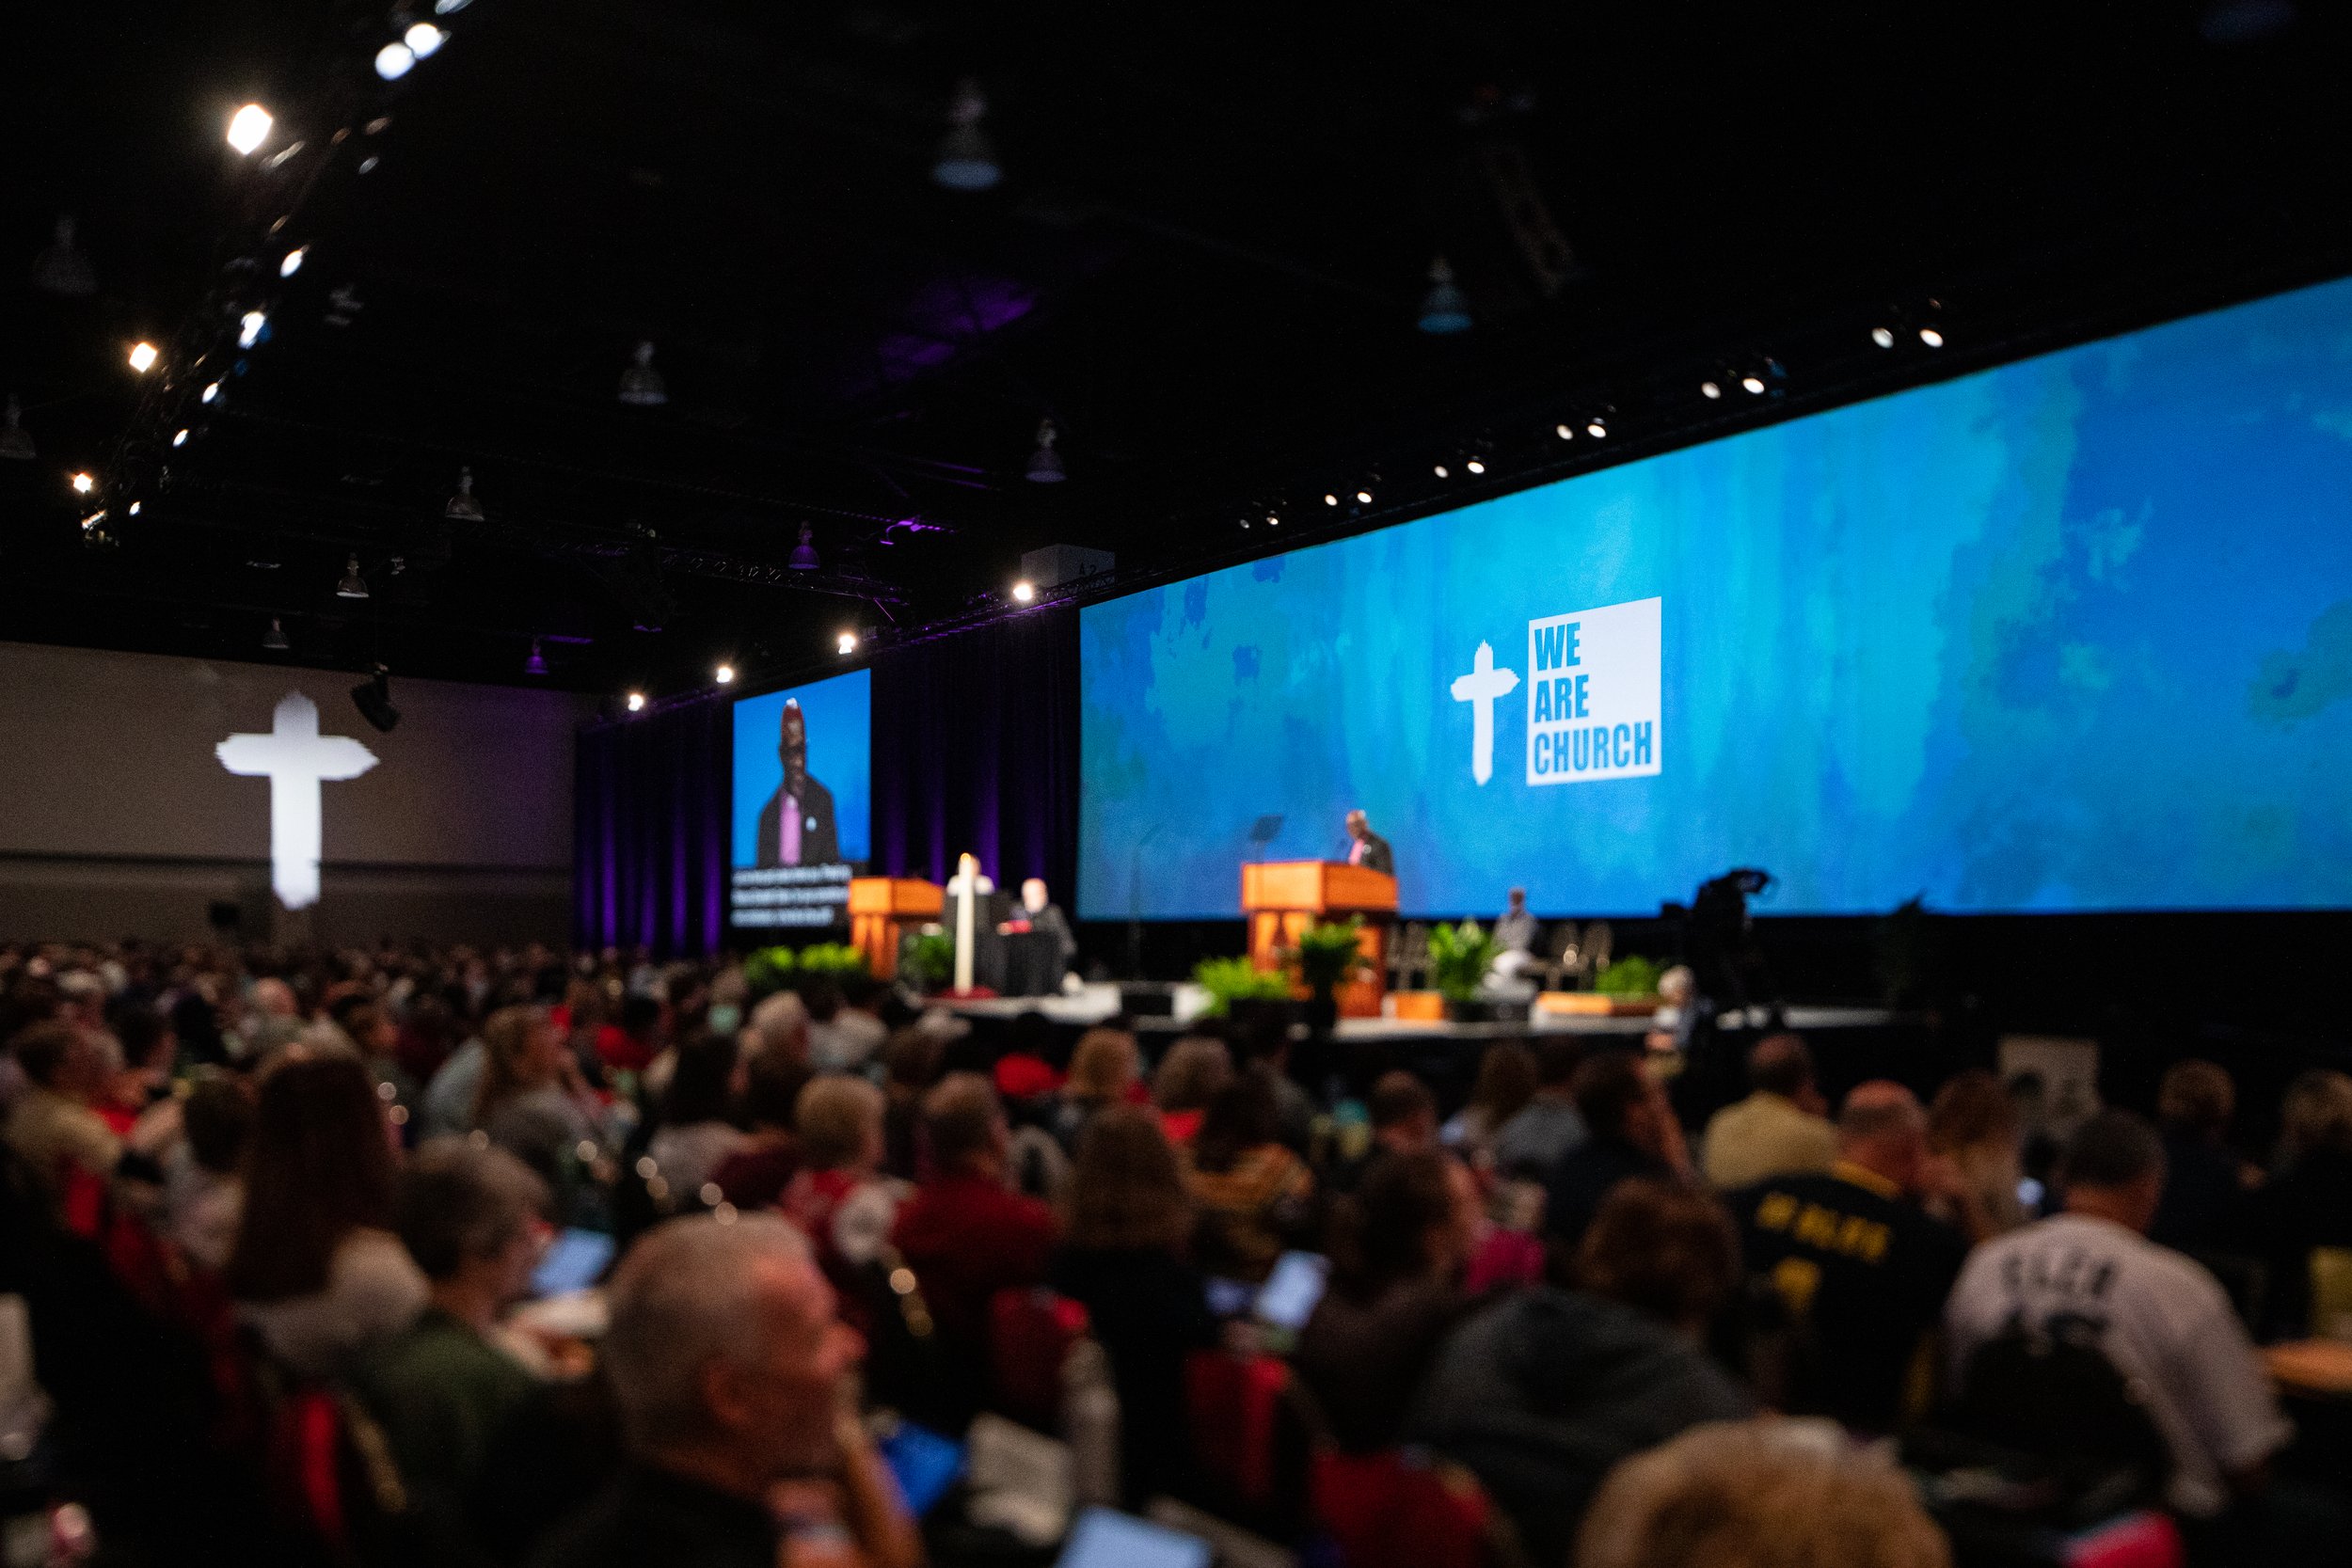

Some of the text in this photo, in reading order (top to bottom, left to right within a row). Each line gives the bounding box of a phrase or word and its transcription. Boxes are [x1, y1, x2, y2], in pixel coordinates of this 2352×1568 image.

[1534, 622, 1581, 672] WE
[1534, 673, 1589, 723] ARE
[1534, 721, 1653, 775] CHURCH
